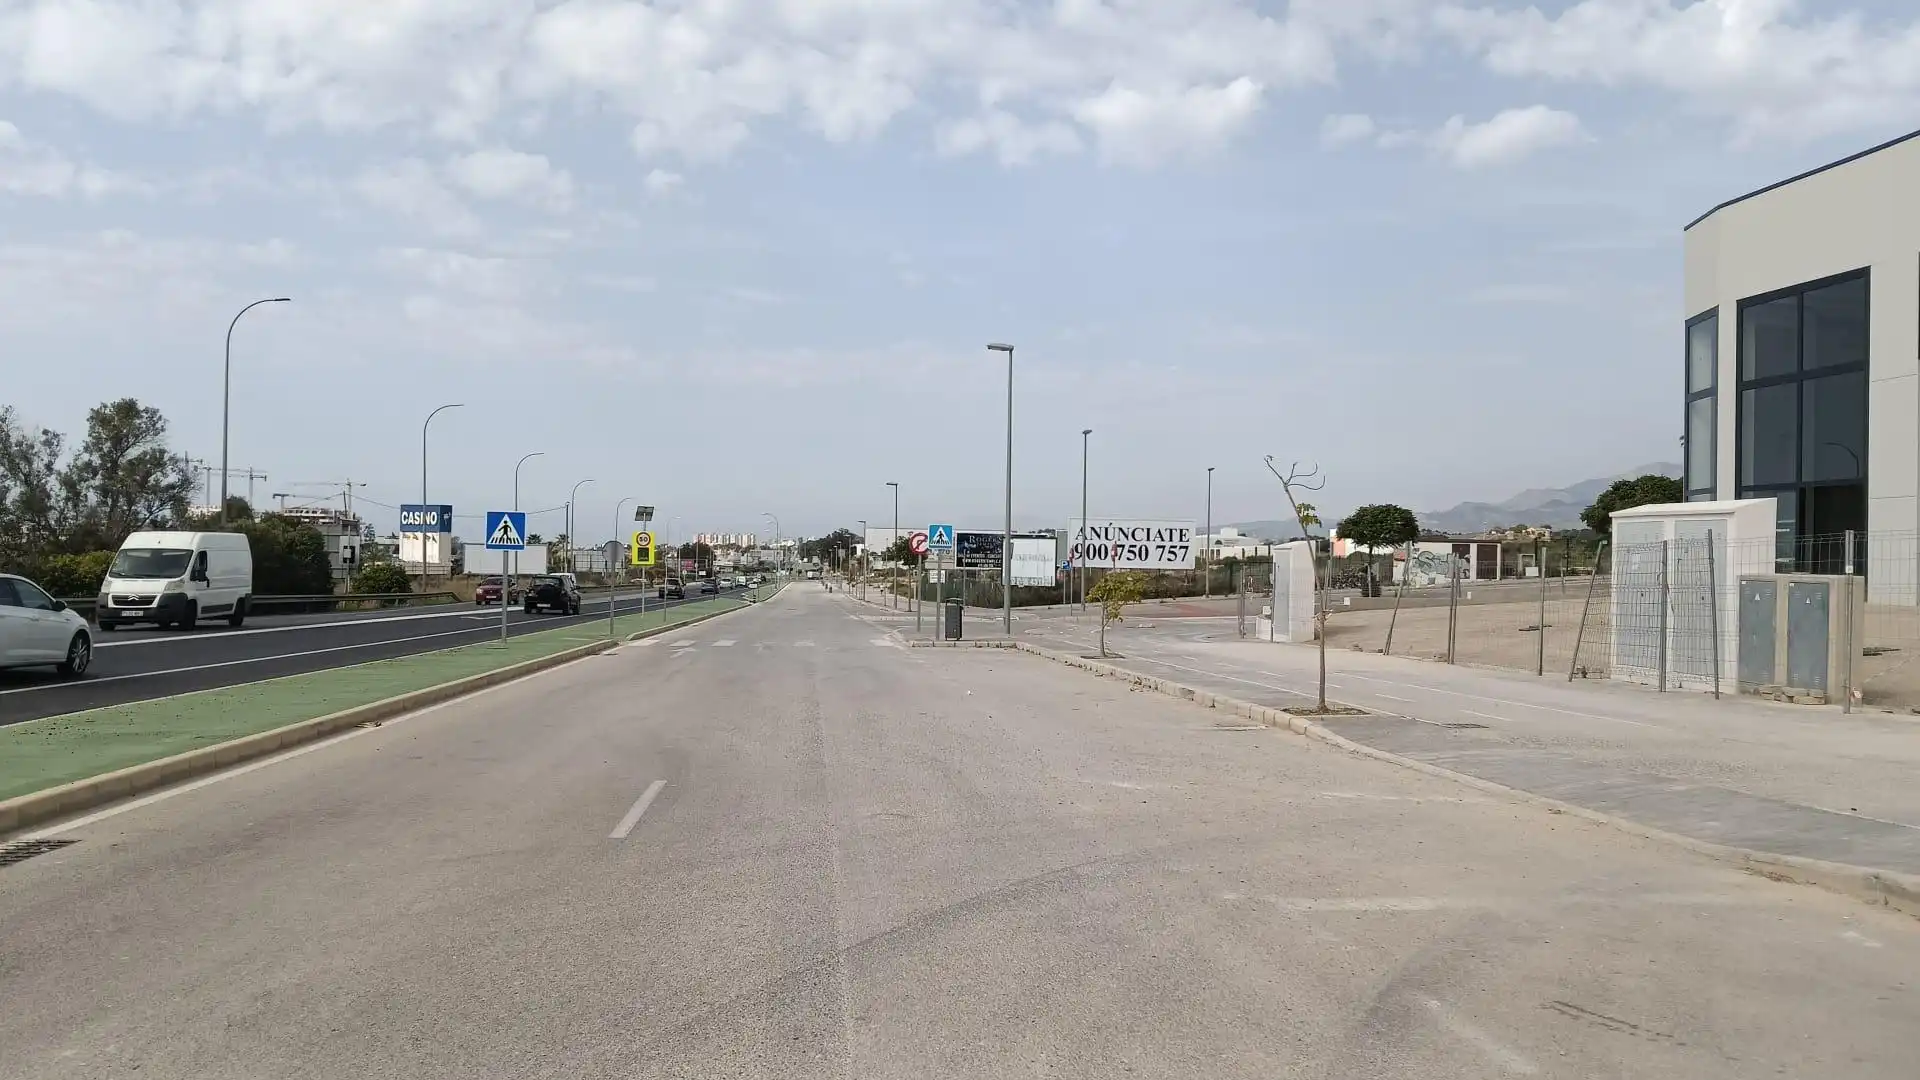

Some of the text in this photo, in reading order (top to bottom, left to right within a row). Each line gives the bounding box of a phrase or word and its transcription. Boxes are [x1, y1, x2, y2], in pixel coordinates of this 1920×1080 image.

[401, 511, 438, 525] CASINO
[1074, 522, 1190, 542] ANÚNCIATE
[1074, 543, 1109, 560] 900
[1116, 544, 1149, 561] 750
[1155, 545, 1190, 562] 757
